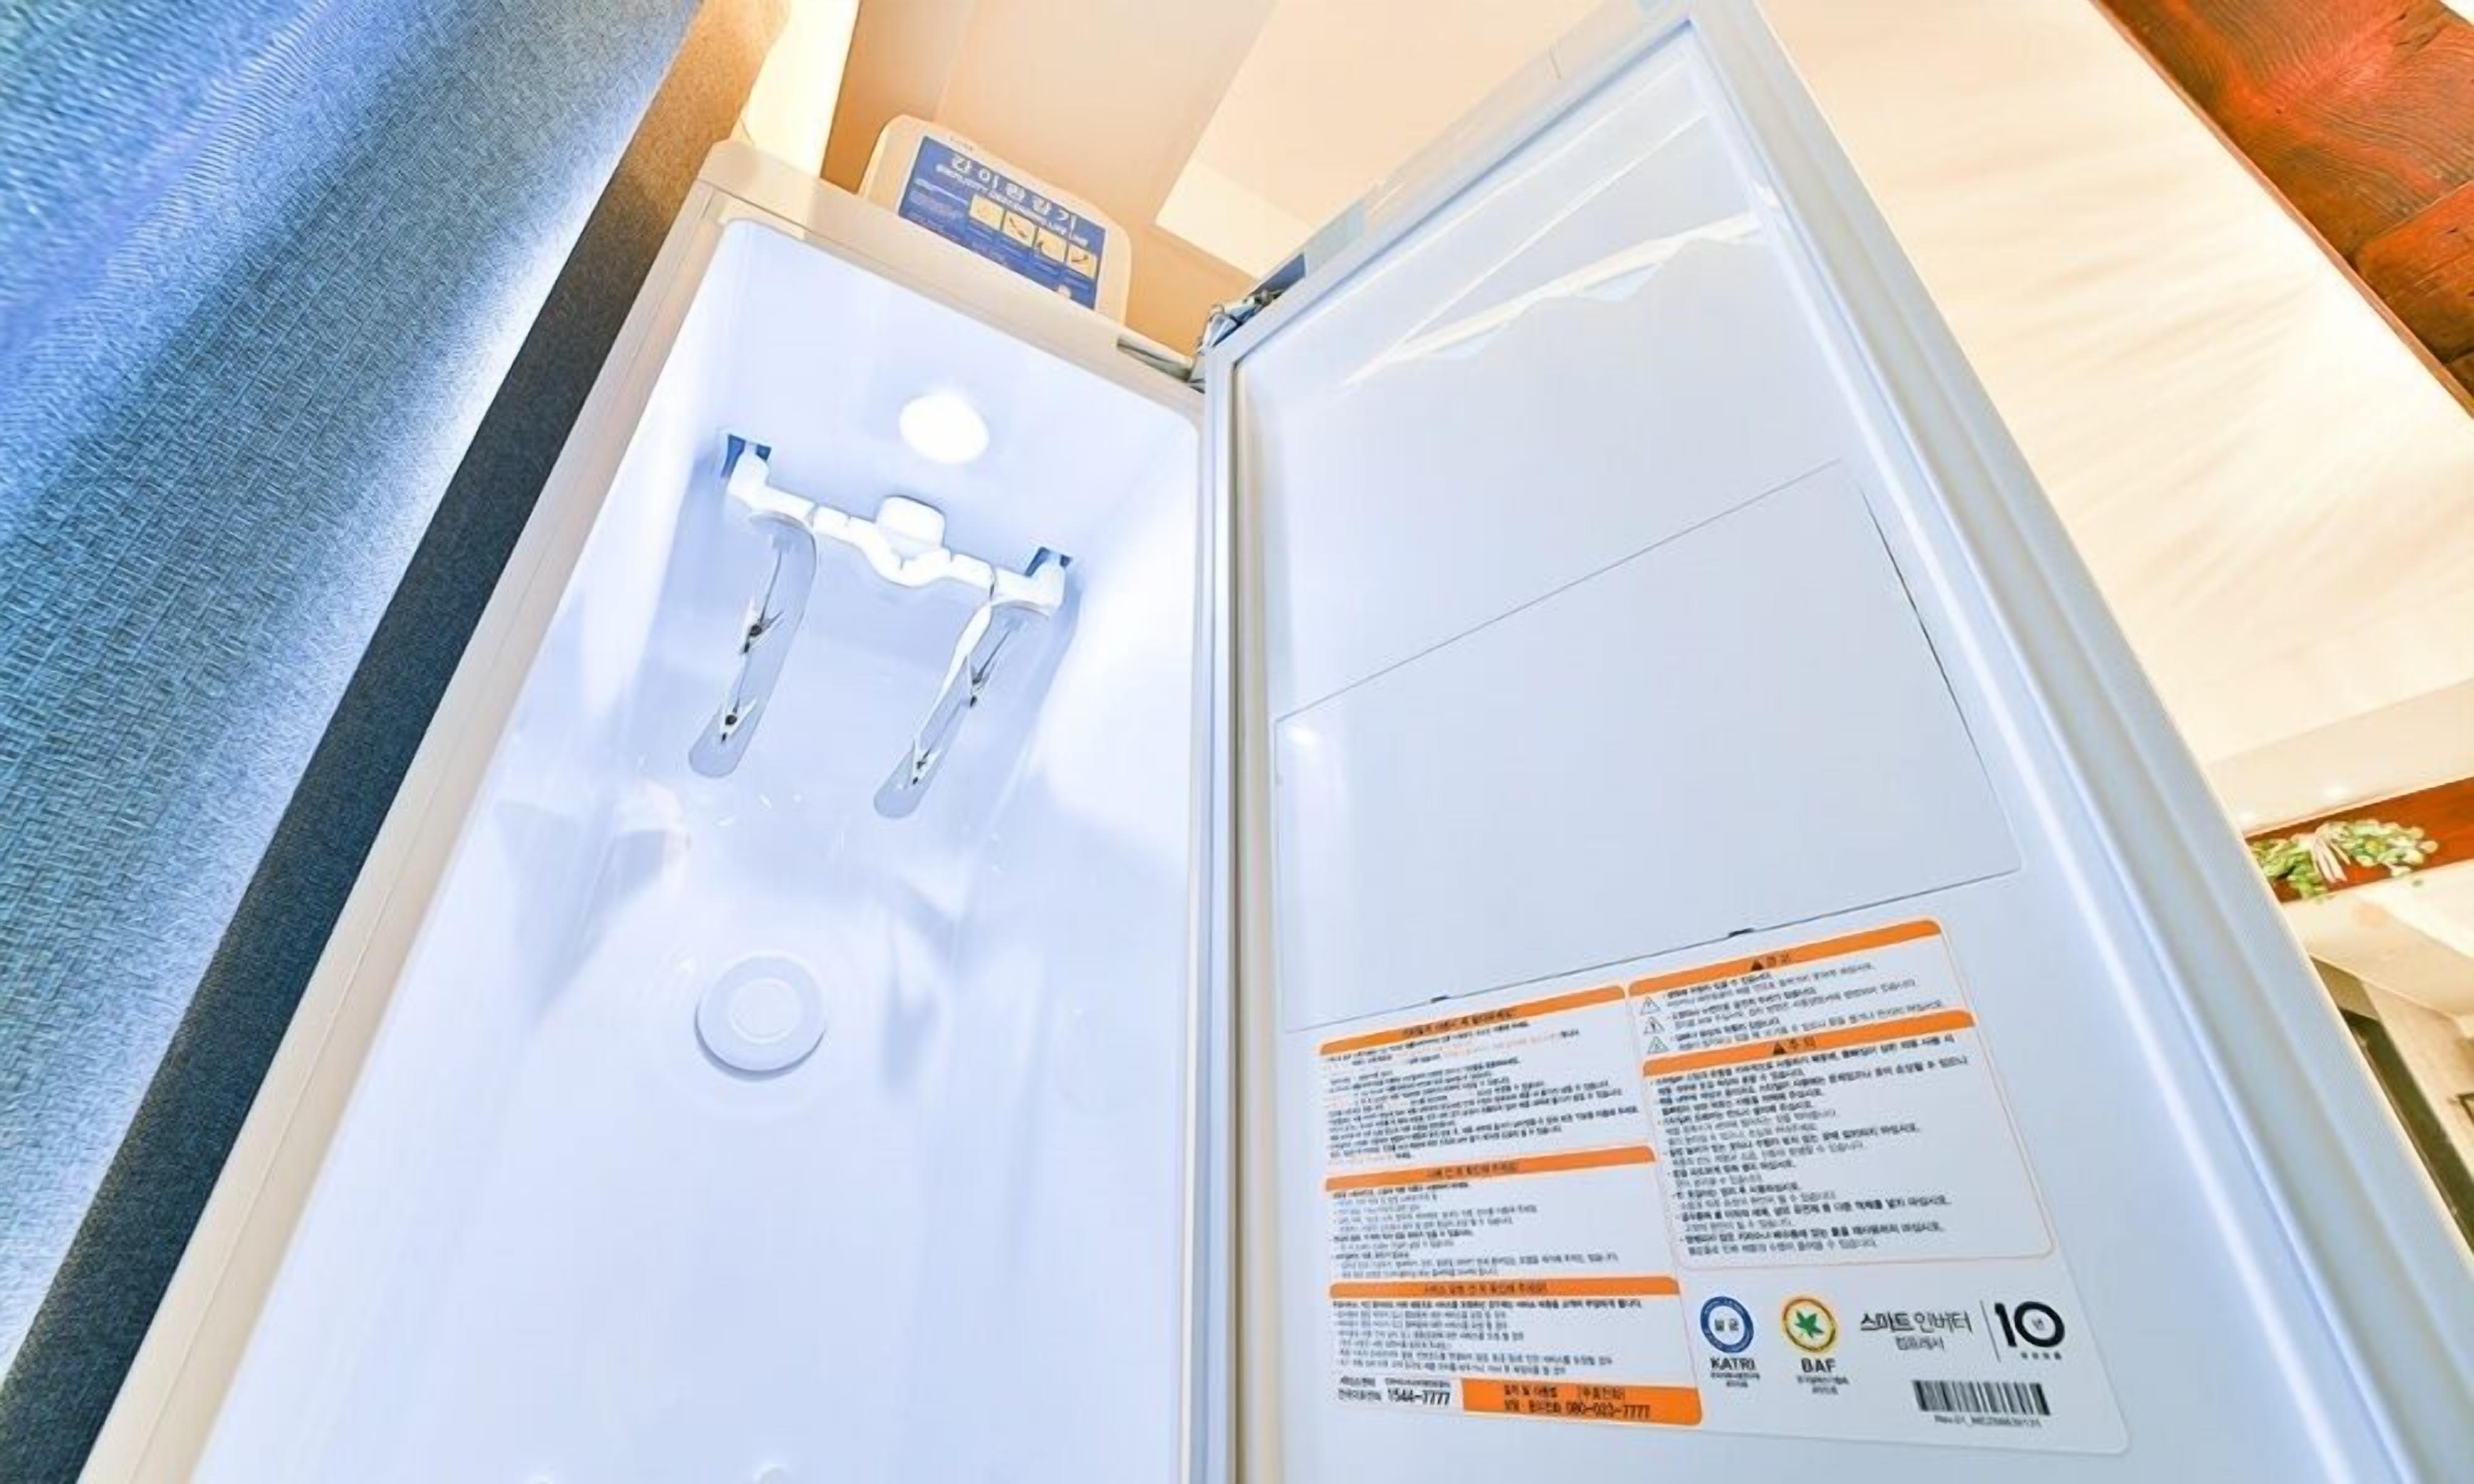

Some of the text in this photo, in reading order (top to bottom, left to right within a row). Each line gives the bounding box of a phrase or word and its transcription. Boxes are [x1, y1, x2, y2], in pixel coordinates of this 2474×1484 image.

[1860, 1310, 1973, 1334] 스마트 인버터
[1995, 1301, 2065, 1347] 10
[1710, 1358, 1755, 1370] KATRI
[1387, 1388, 1450, 1405] 1544-7777
